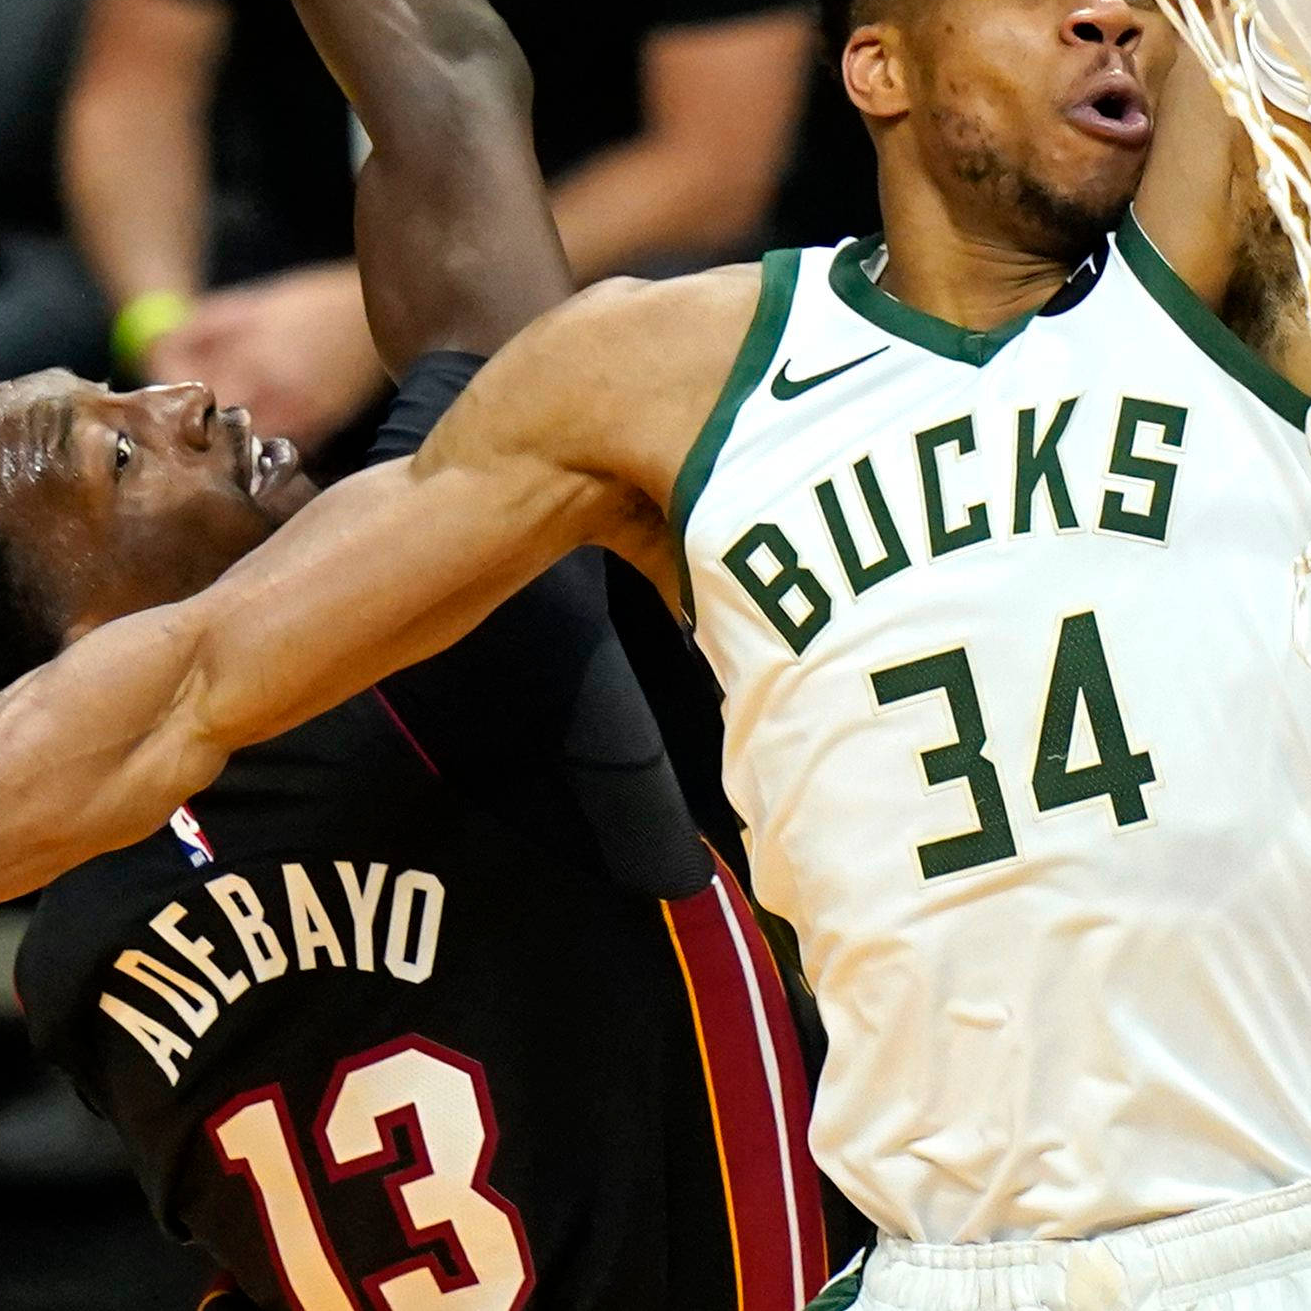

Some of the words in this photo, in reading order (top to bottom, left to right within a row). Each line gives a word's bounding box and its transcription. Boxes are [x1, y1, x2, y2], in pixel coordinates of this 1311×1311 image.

[717, 389, 1192, 663] BUCKS
[865, 605, 1165, 888] 34
[99, 860, 445, 1087] ADEBAYO
[205, 1032, 536, 1311] 13
